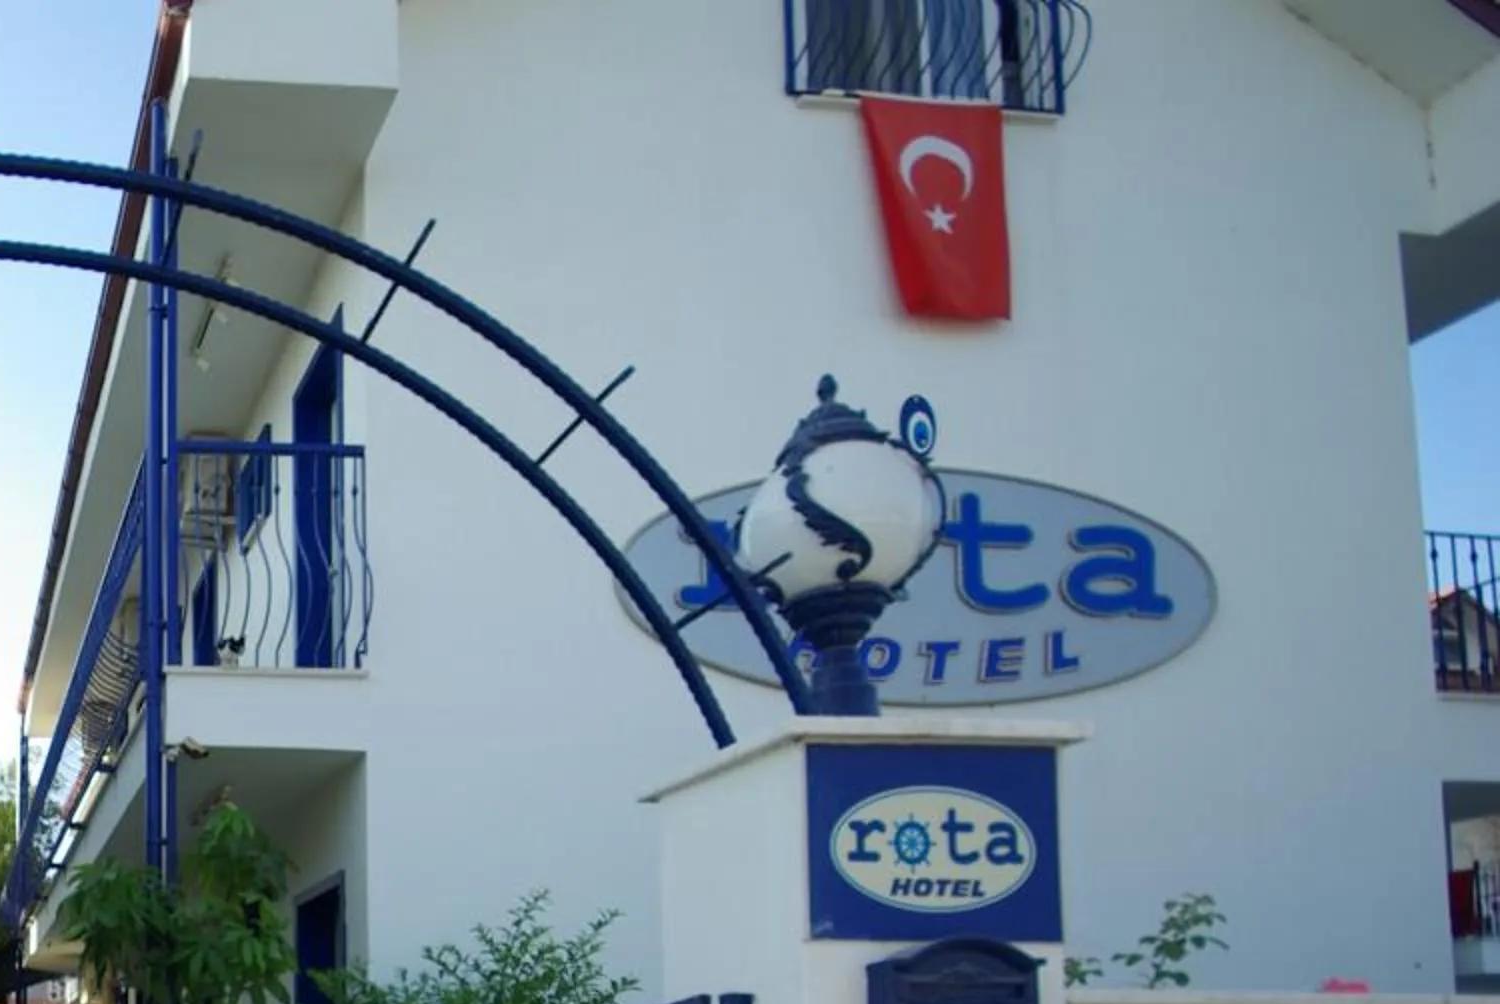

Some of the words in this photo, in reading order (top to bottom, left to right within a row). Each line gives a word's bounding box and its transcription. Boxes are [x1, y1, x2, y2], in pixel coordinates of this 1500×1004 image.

[678, 491, 1175, 617] ta
[846, 808, 1025, 868] rota
[890, 877, 987, 899] HOTEL
